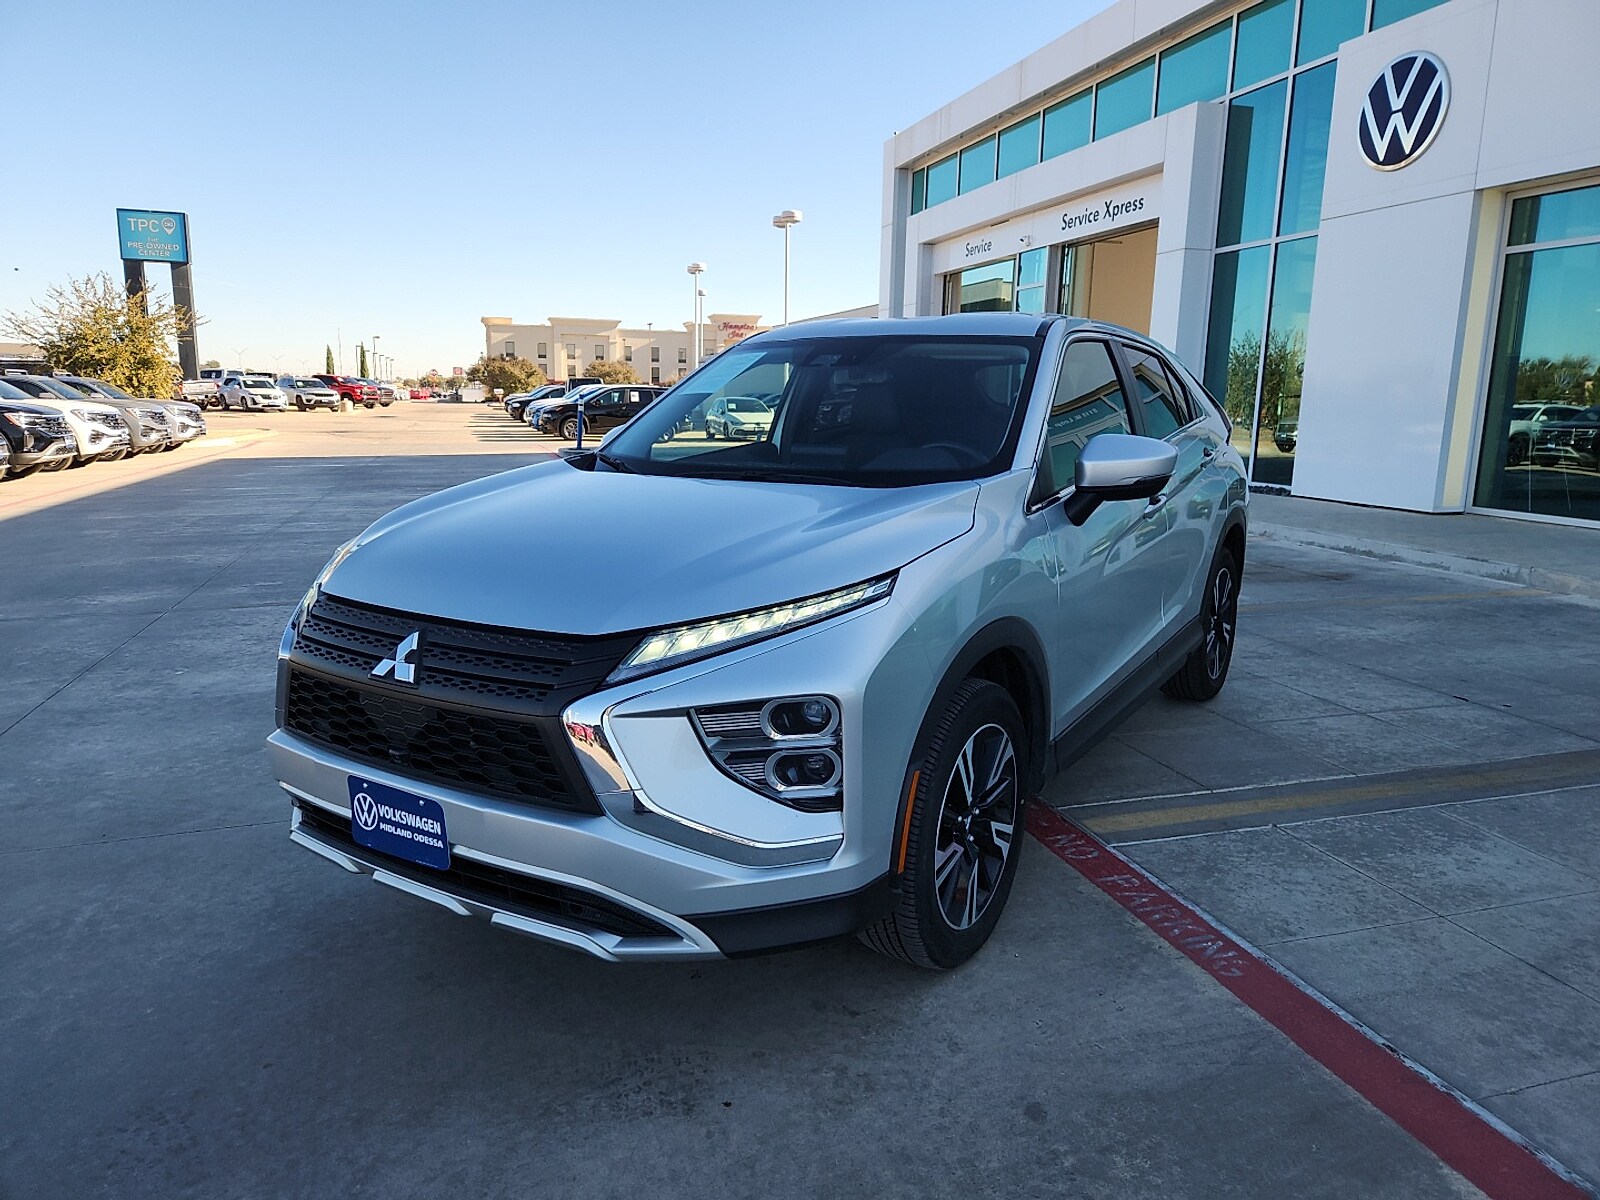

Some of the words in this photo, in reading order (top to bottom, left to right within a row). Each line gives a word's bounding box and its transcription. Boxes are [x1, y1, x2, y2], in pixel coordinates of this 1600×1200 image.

[1060, 208, 1100, 231] Service
[1103, 198, 1145, 221] Xpress
[126, 217, 159, 232] TPC
[127, 241, 179, 251] PRE-OWNED
[138, 249, 170, 257] CENTER
[965, 238, 993, 257] Service
[718, 322, 757, 331] Hampton
[378, 803, 442, 835] VOLKSWAGEN
[380, 822, 412, 839] MIDLAND
[413, 832, 444, 849] ODESSA
[1047, 834, 1100, 860] NO
[1098, 874, 1251, 977] PARKING
